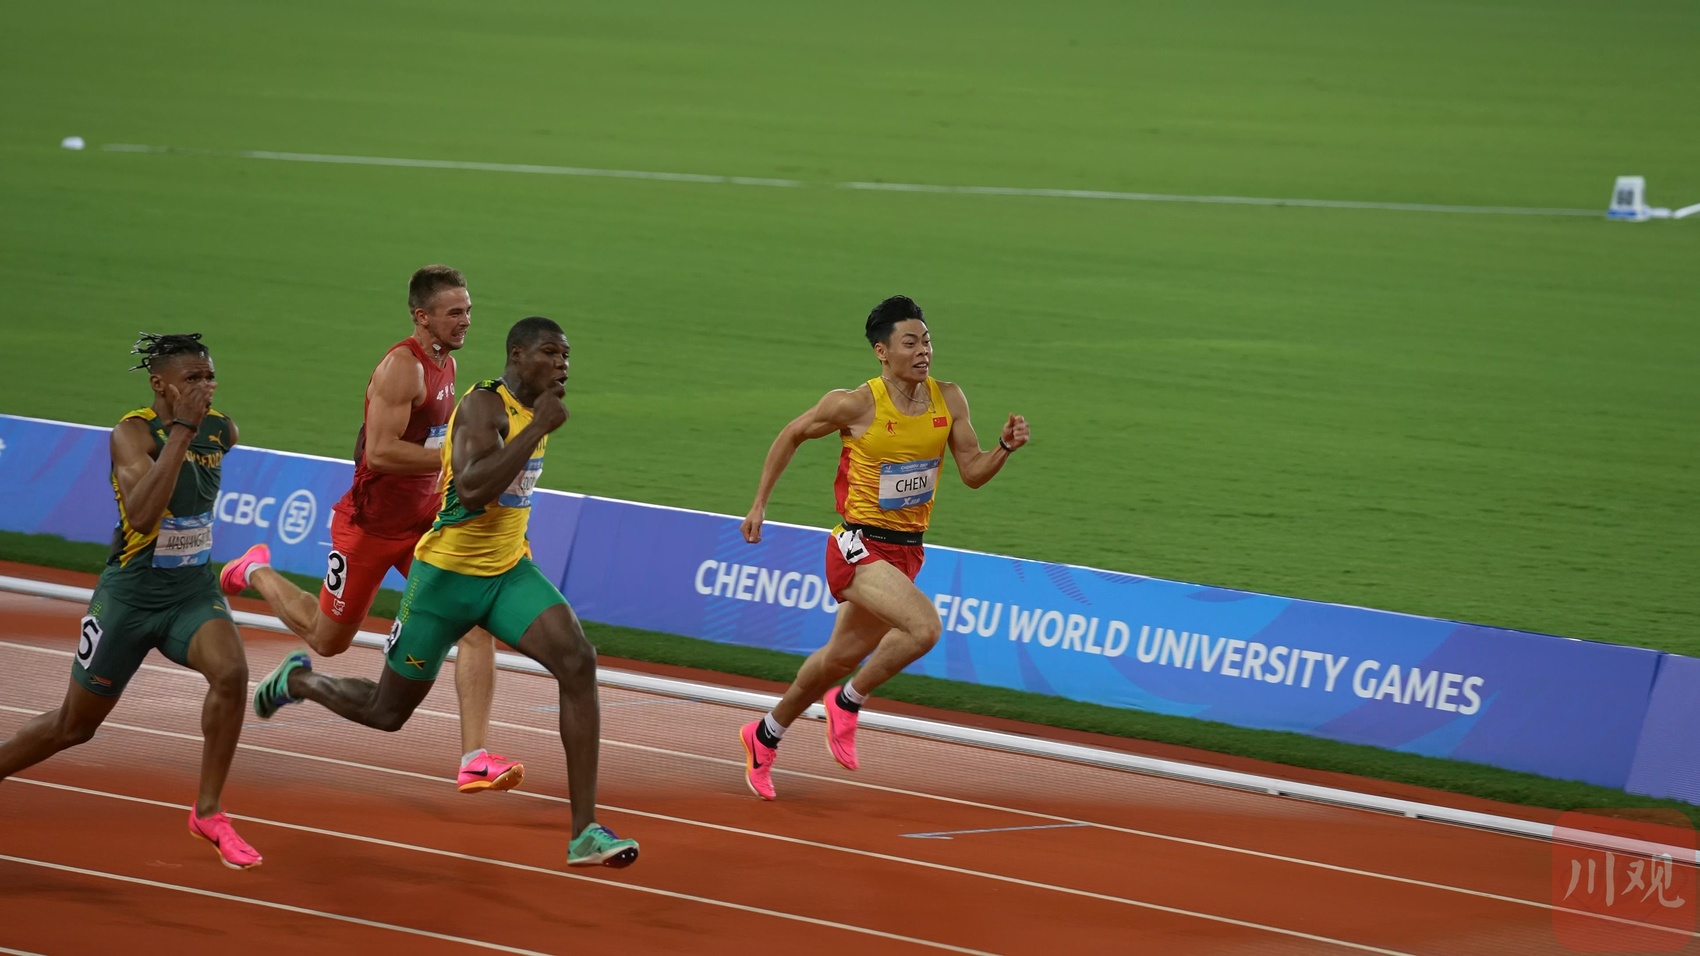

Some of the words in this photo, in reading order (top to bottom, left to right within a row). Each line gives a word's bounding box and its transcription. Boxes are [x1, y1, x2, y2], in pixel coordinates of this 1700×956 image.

[895, 475, 928, 493] CHEN
[213, 489, 277, 528] ICBC
[327, 552, 345, 591] 3
[78, 618, 99, 661] 5
[694, 558, 839, 614] CHENGDU
[933, 593, 1002, 638] FISU
[1008, 604, 1130, 658] WORLD
[1135, 625, 1350, 692] UNIVERSITY
[1352, 659, 1485, 716] GAMES
